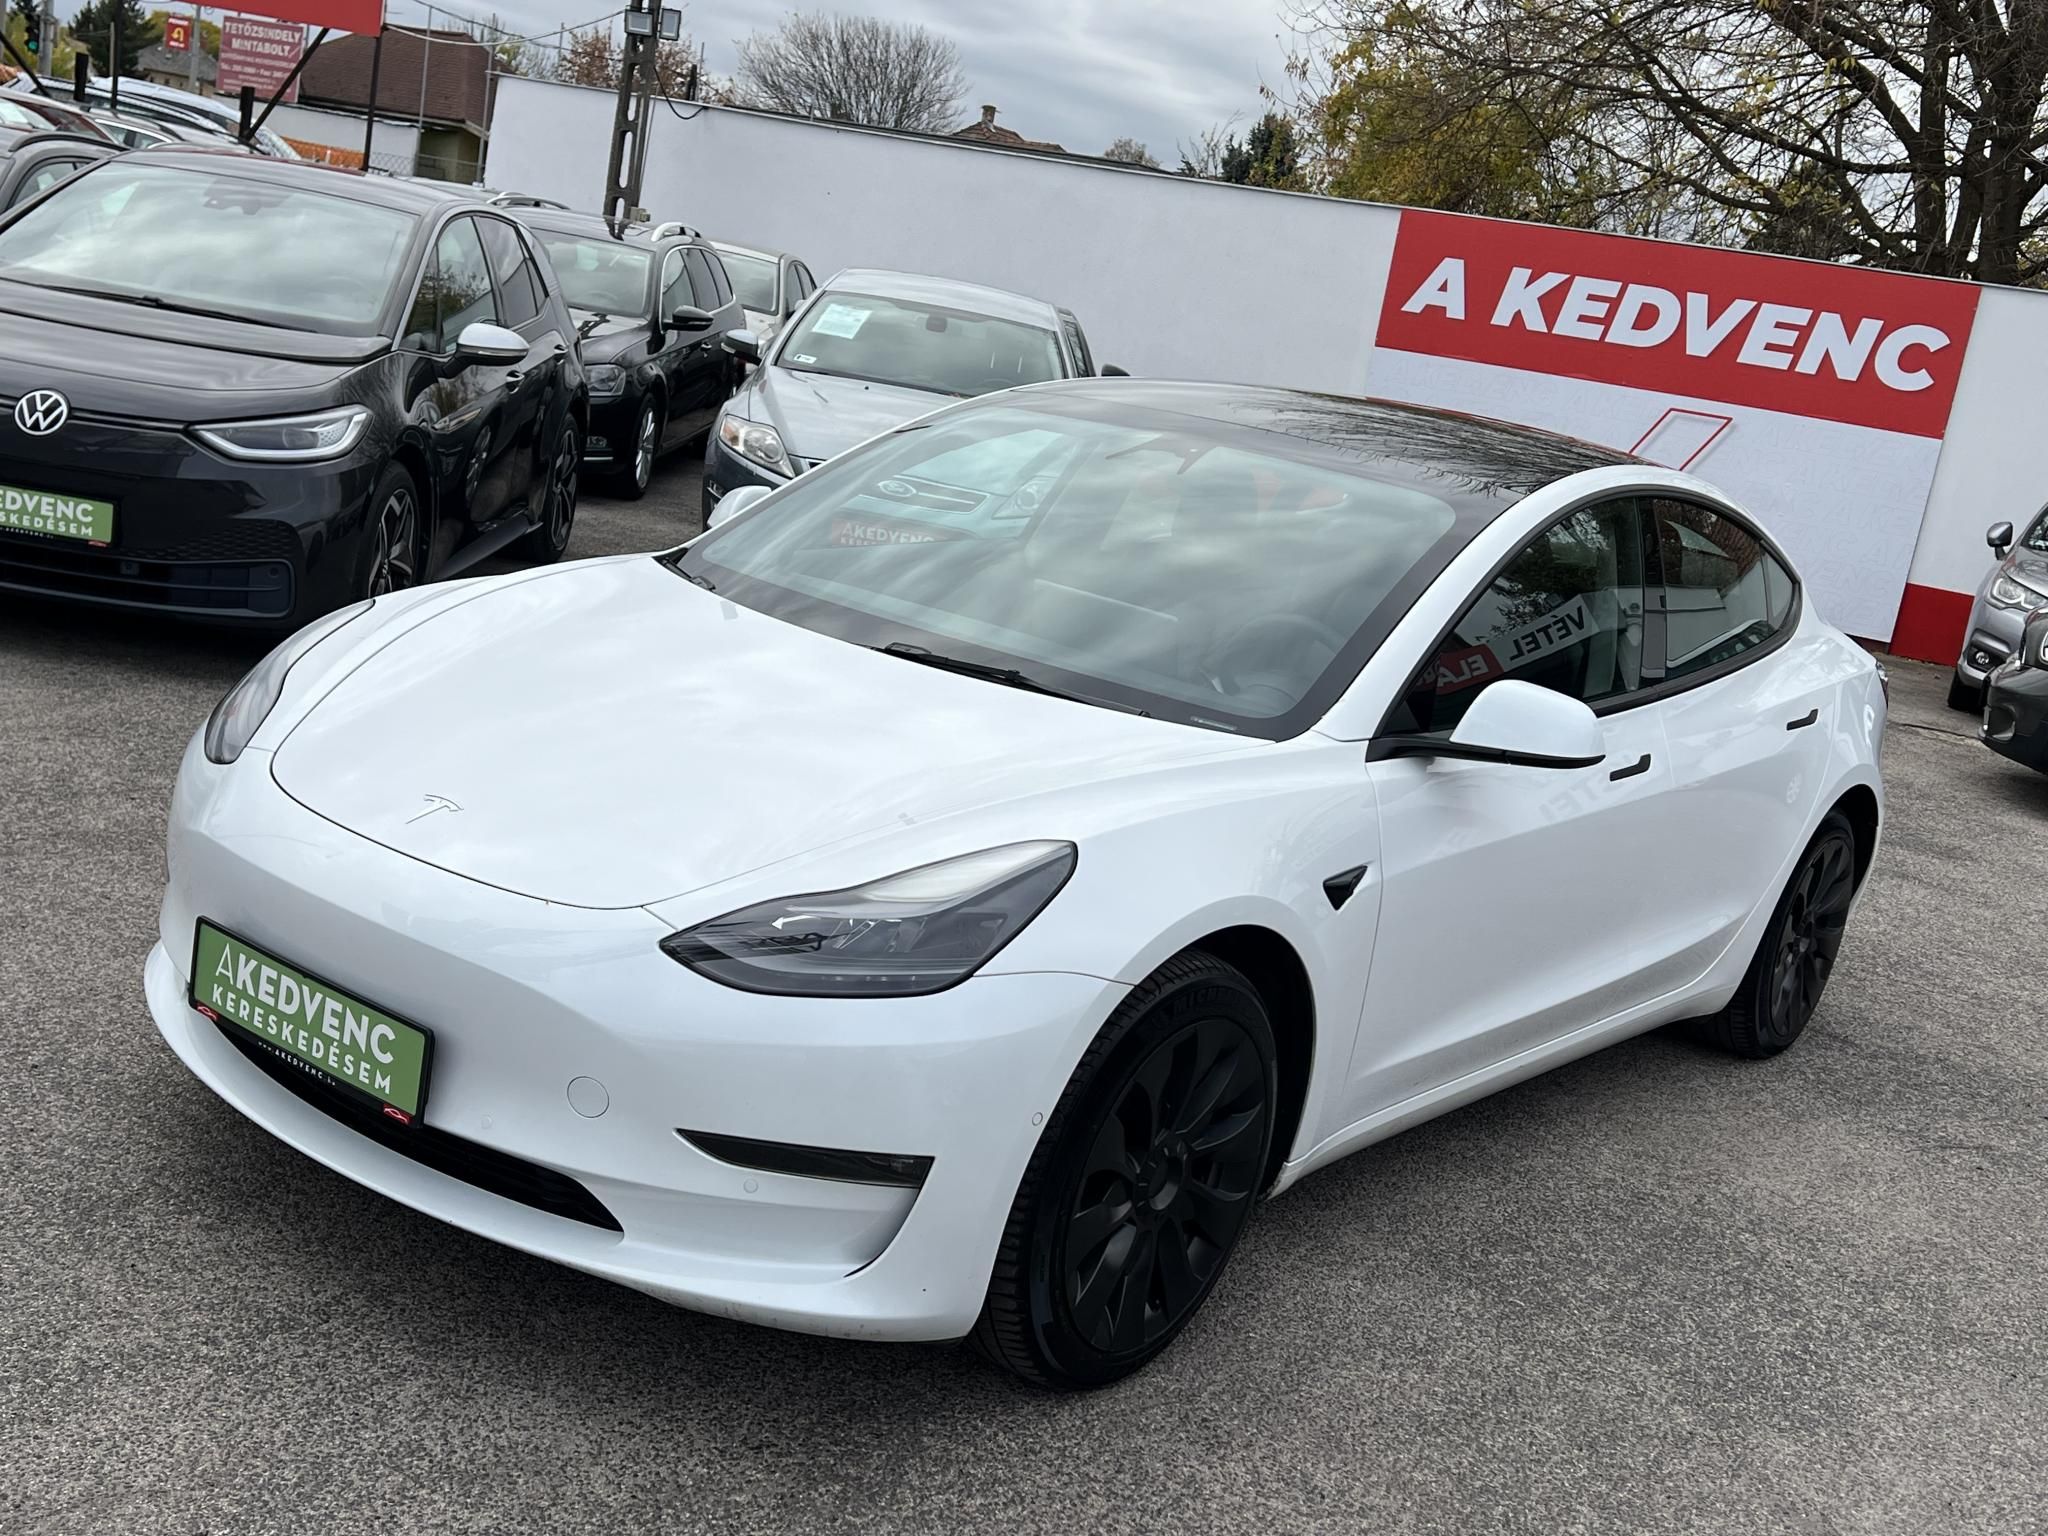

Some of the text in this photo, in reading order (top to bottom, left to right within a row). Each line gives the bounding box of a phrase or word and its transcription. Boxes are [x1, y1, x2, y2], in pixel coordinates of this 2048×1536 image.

[1401, 257, 1951, 392] A KEDVENC
[212, 984, 392, 1095] KERESKEDÉSEM
